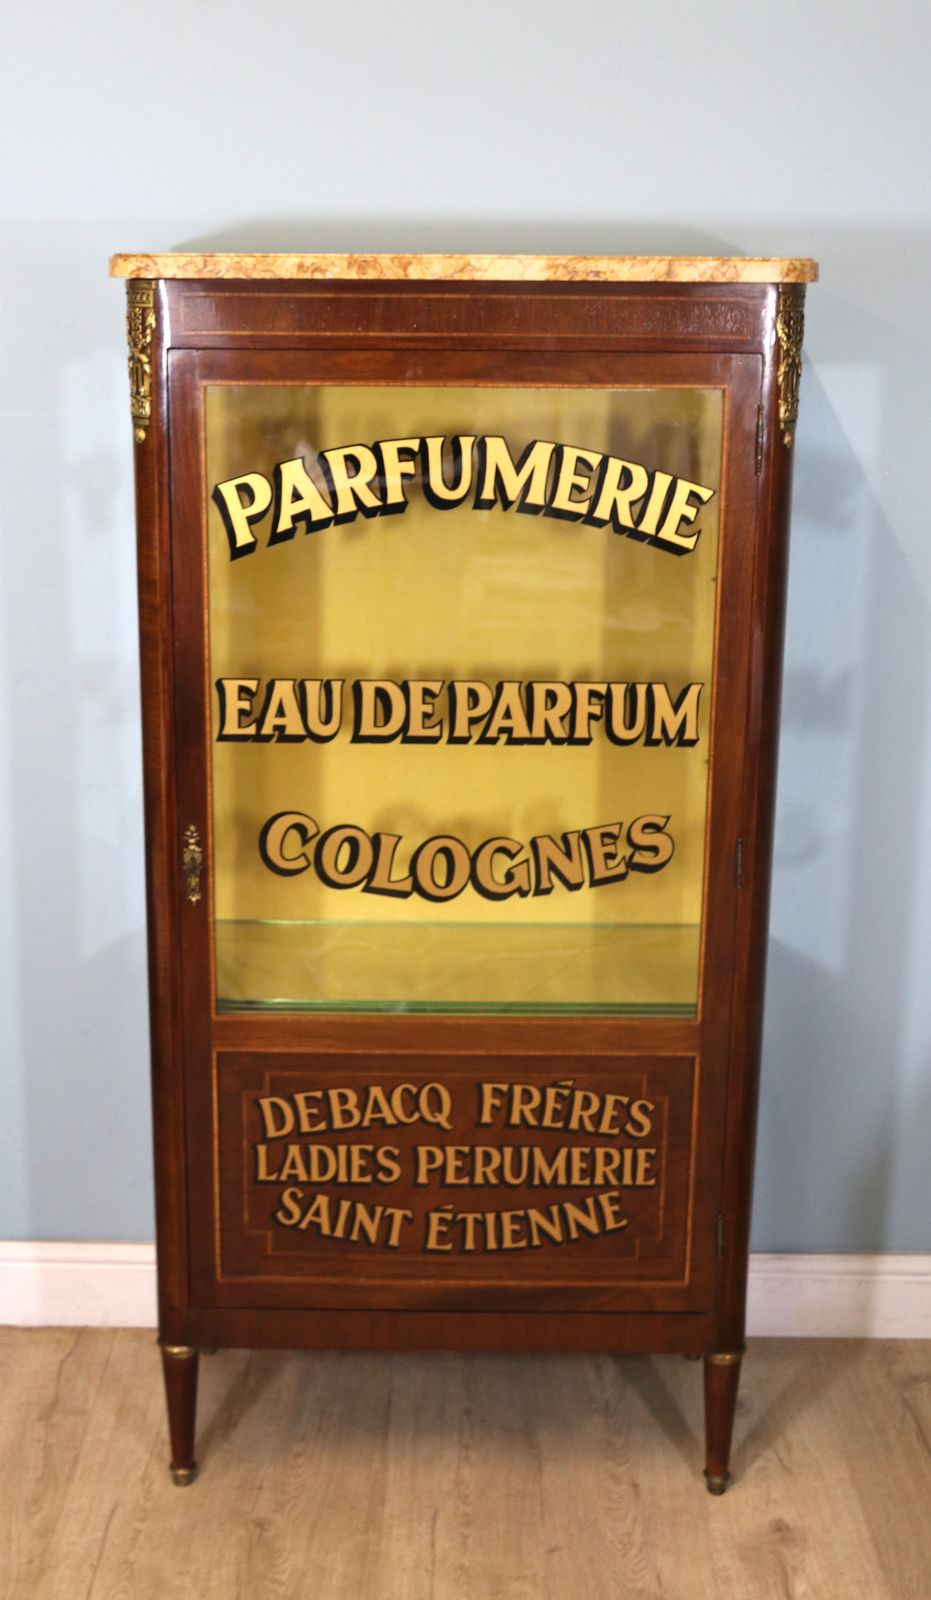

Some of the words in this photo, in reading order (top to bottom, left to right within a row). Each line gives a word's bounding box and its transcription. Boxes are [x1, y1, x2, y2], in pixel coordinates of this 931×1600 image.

[212, 434, 716, 561] PARFUMERIE
[215, 677, 344, 744] EAU
[258, 811, 675, 902] COLOGNES
[258, 1082, 454, 1139] DEBACQ
[255, 1143, 401, 1184] LADIES
[416, 1145, 657, 1186] PERUMERIE
[275, 1187, 413, 1248] SAINT
[425, 1191, 628, 1251] ÉTIENNE
